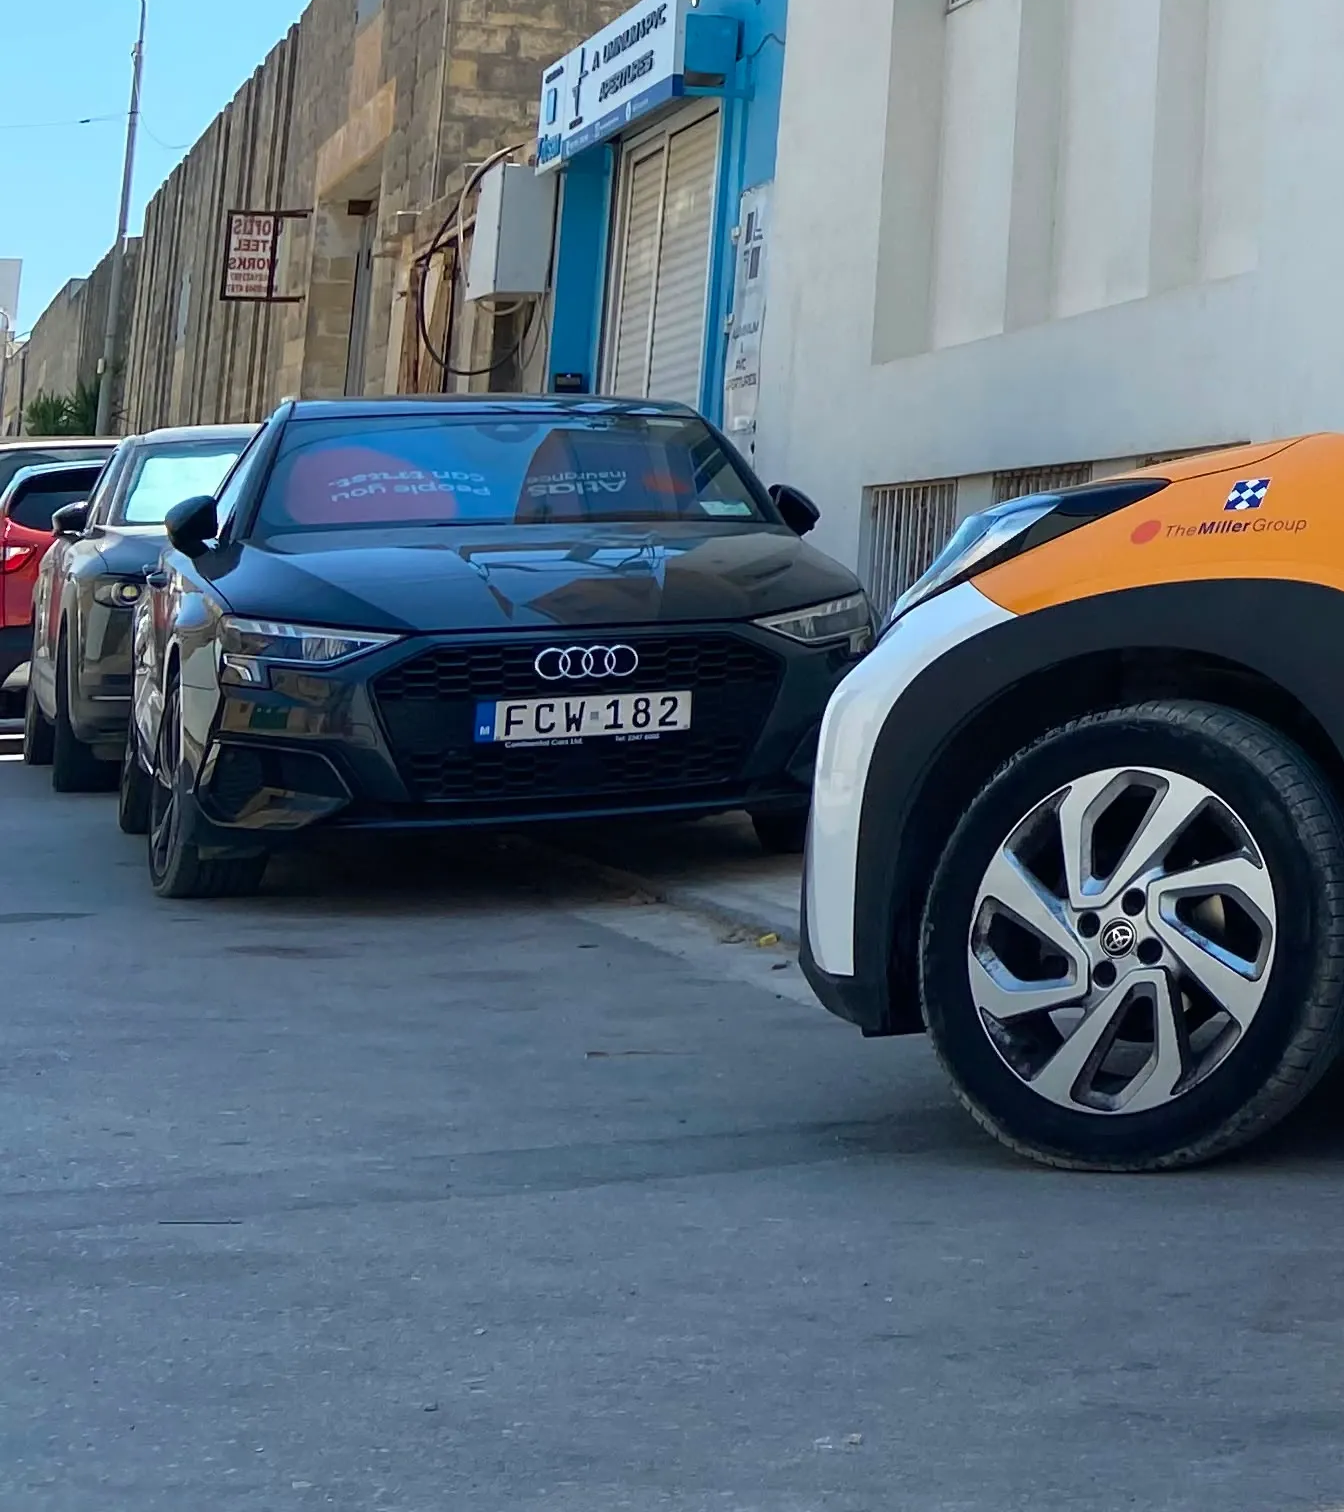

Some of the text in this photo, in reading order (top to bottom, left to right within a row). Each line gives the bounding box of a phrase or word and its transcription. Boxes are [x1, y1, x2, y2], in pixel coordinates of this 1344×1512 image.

[527, 471, 627, 485] insurance
[527, 479, 627, 498] Atlas
[504, 701, 586, 737] FCW
[604, 696, 679, 730] 182
